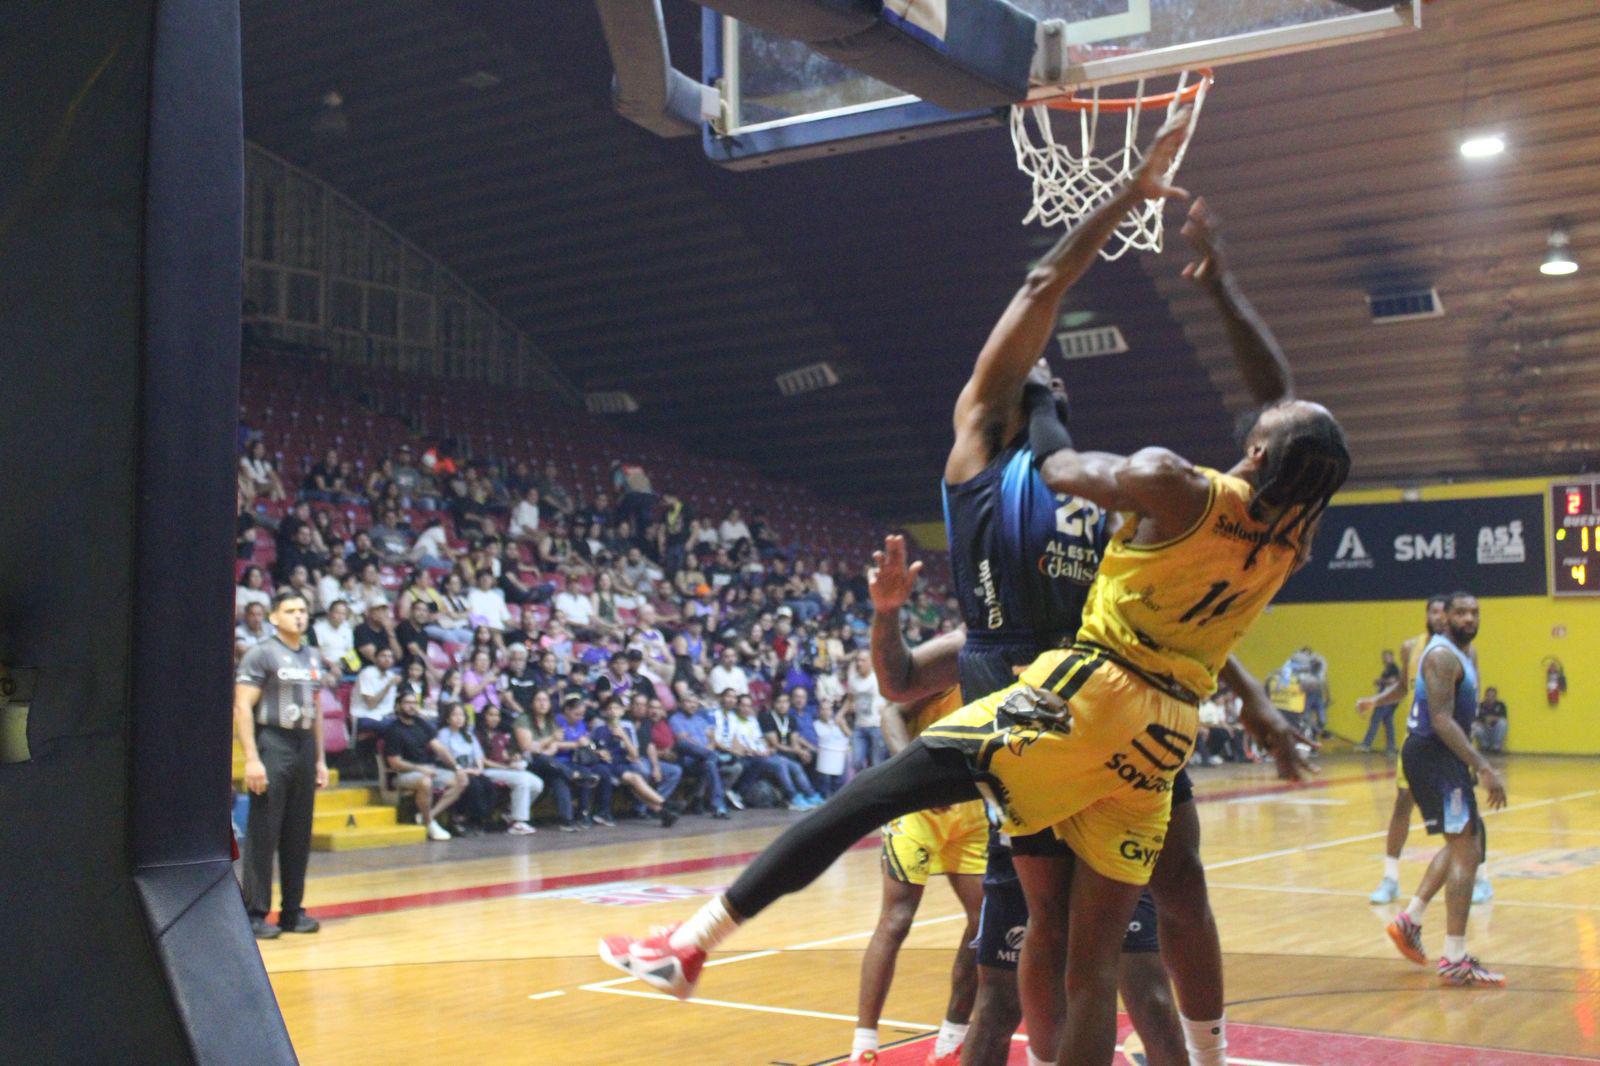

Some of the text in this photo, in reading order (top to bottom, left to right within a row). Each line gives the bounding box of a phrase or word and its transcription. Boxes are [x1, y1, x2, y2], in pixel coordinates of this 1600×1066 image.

[1567, 492, 1581, 514] 2
[1047, 556, 1096, 580] Jalis
[1571, 564, 1585, 585] 4
[997, 950, 1019, 962] ME
